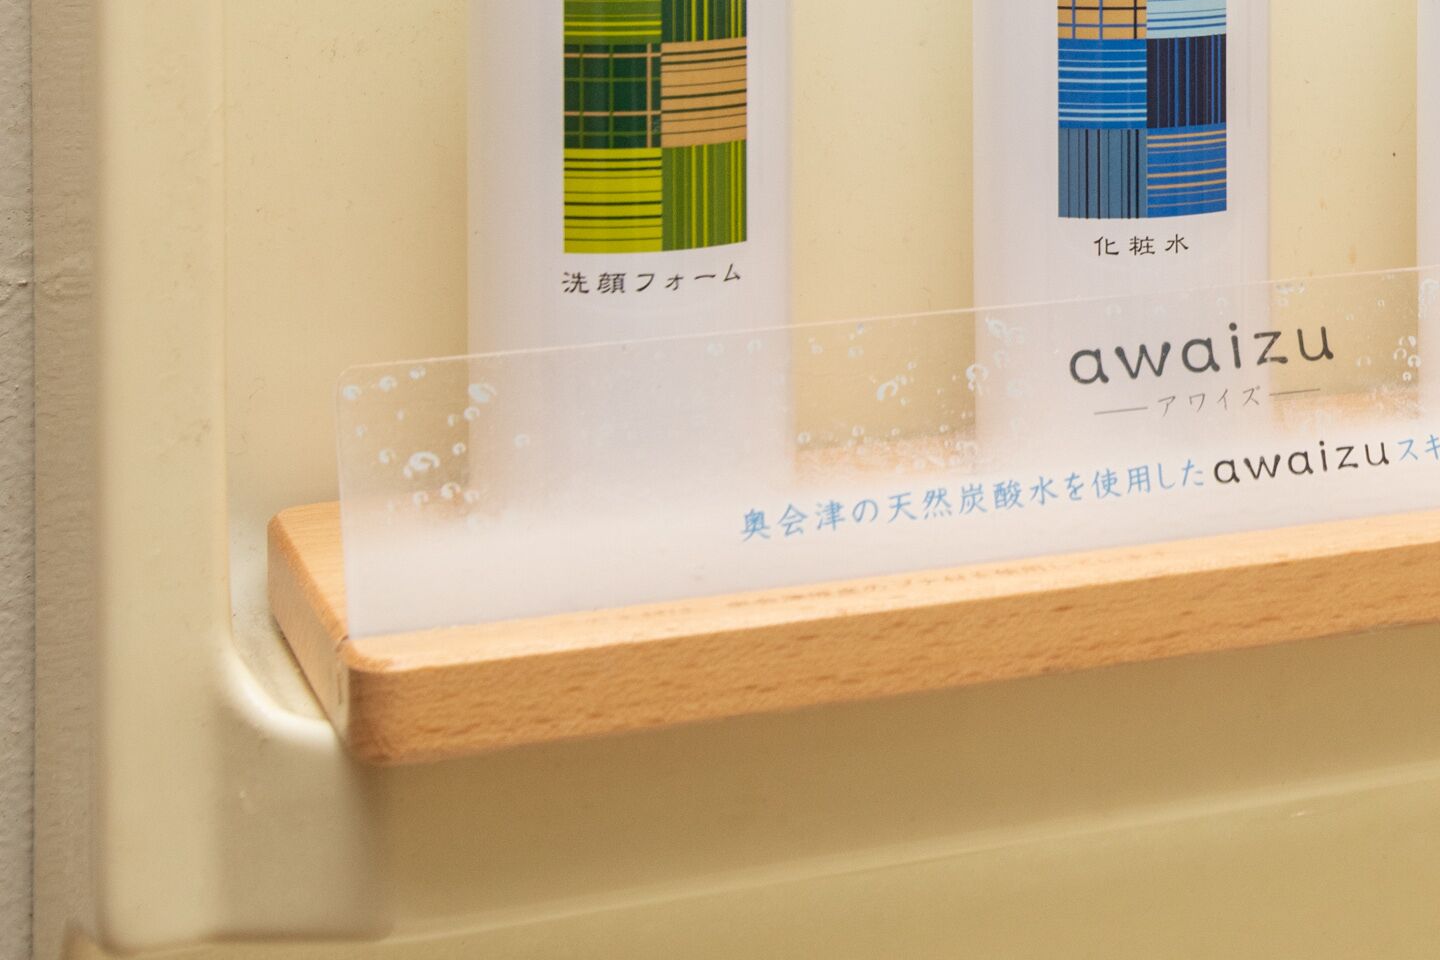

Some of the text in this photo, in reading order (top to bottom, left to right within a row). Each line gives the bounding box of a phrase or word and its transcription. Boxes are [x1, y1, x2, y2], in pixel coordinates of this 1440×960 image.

[1093, 234, 1189, 257] 化粧水
[561, 263, 742, 294] 洗顔フォーム
[1069, 322, 1334, 385] awaizu
[1157, 385, 1261, 418] アワイズ
